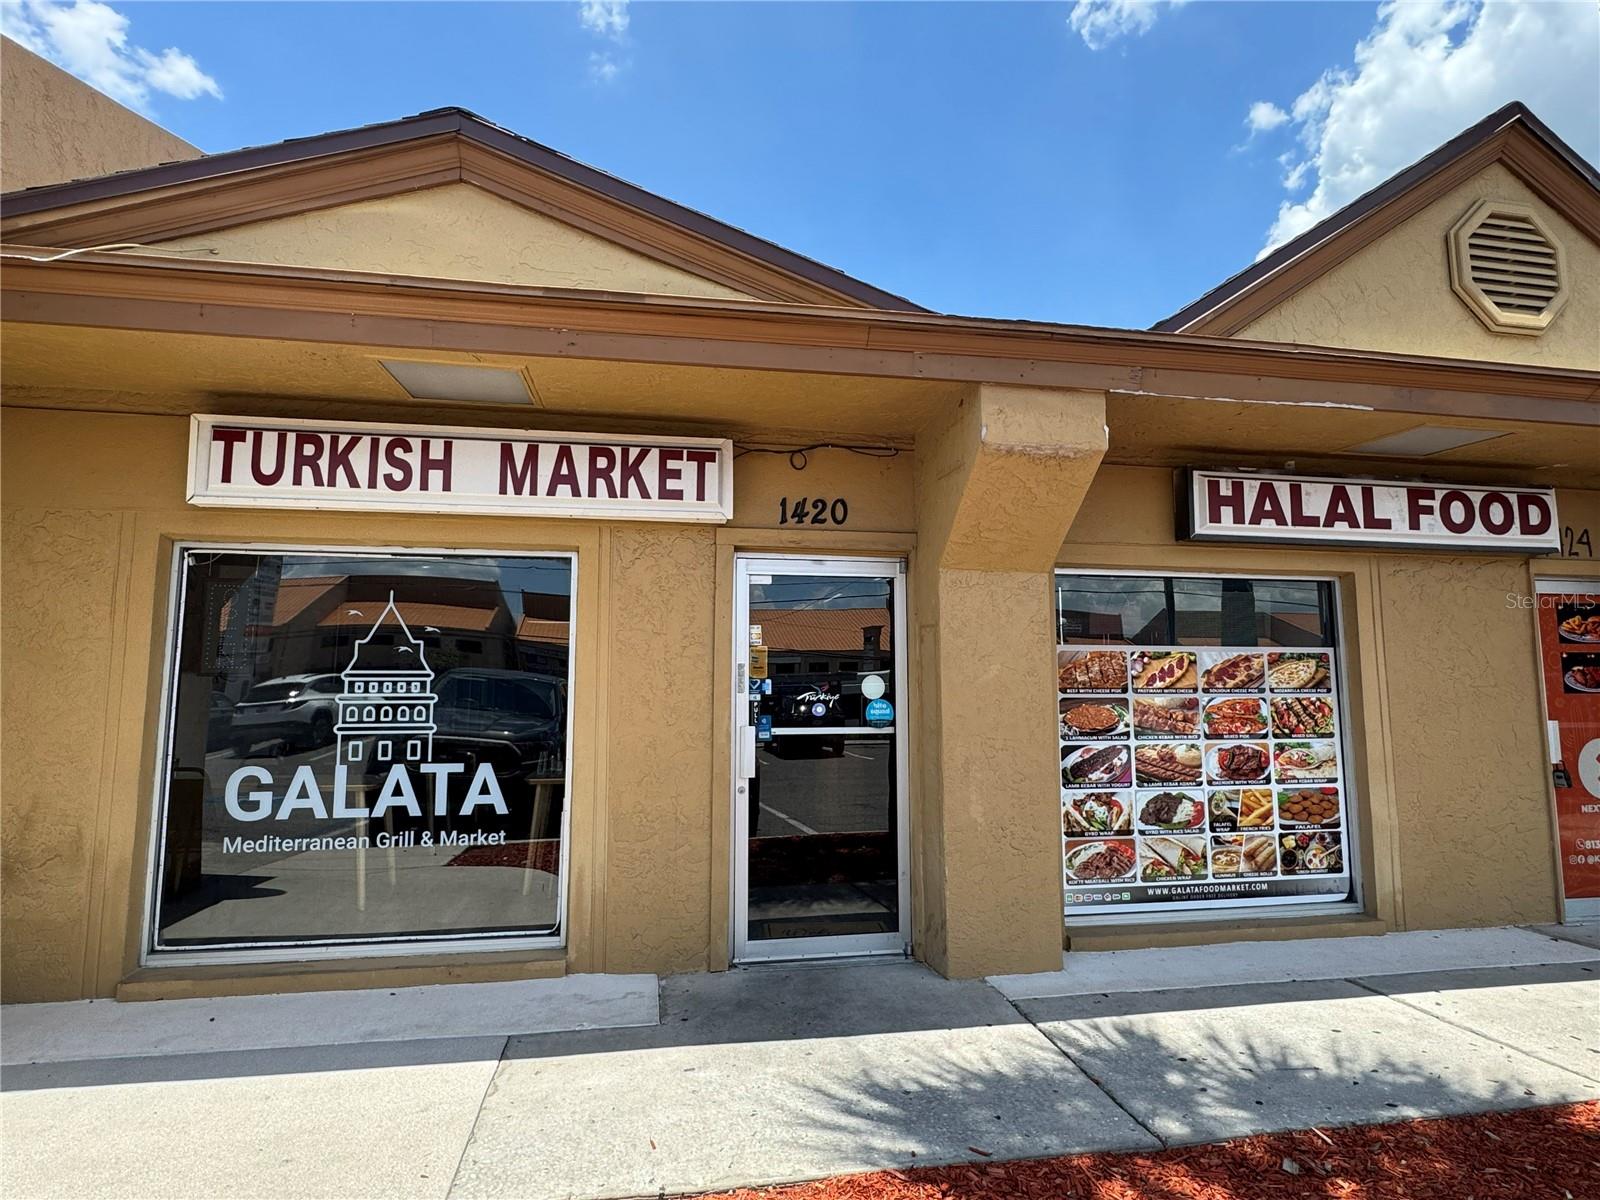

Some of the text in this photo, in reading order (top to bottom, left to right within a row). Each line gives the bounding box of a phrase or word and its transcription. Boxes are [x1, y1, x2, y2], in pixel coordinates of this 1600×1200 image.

[212, 429, 716, 502] TURKISH MARKET
[779, 496, 848, 525] 1420
[1207, 479, 1552, 536] HALAL FOOD
[224, 762, 509, 822] GALATA
[222, 829, 506, 854] Mediterranean Grill & Market
[1147, 882, 1268, 896] WWW.GALATAFOODMARKET.COM
